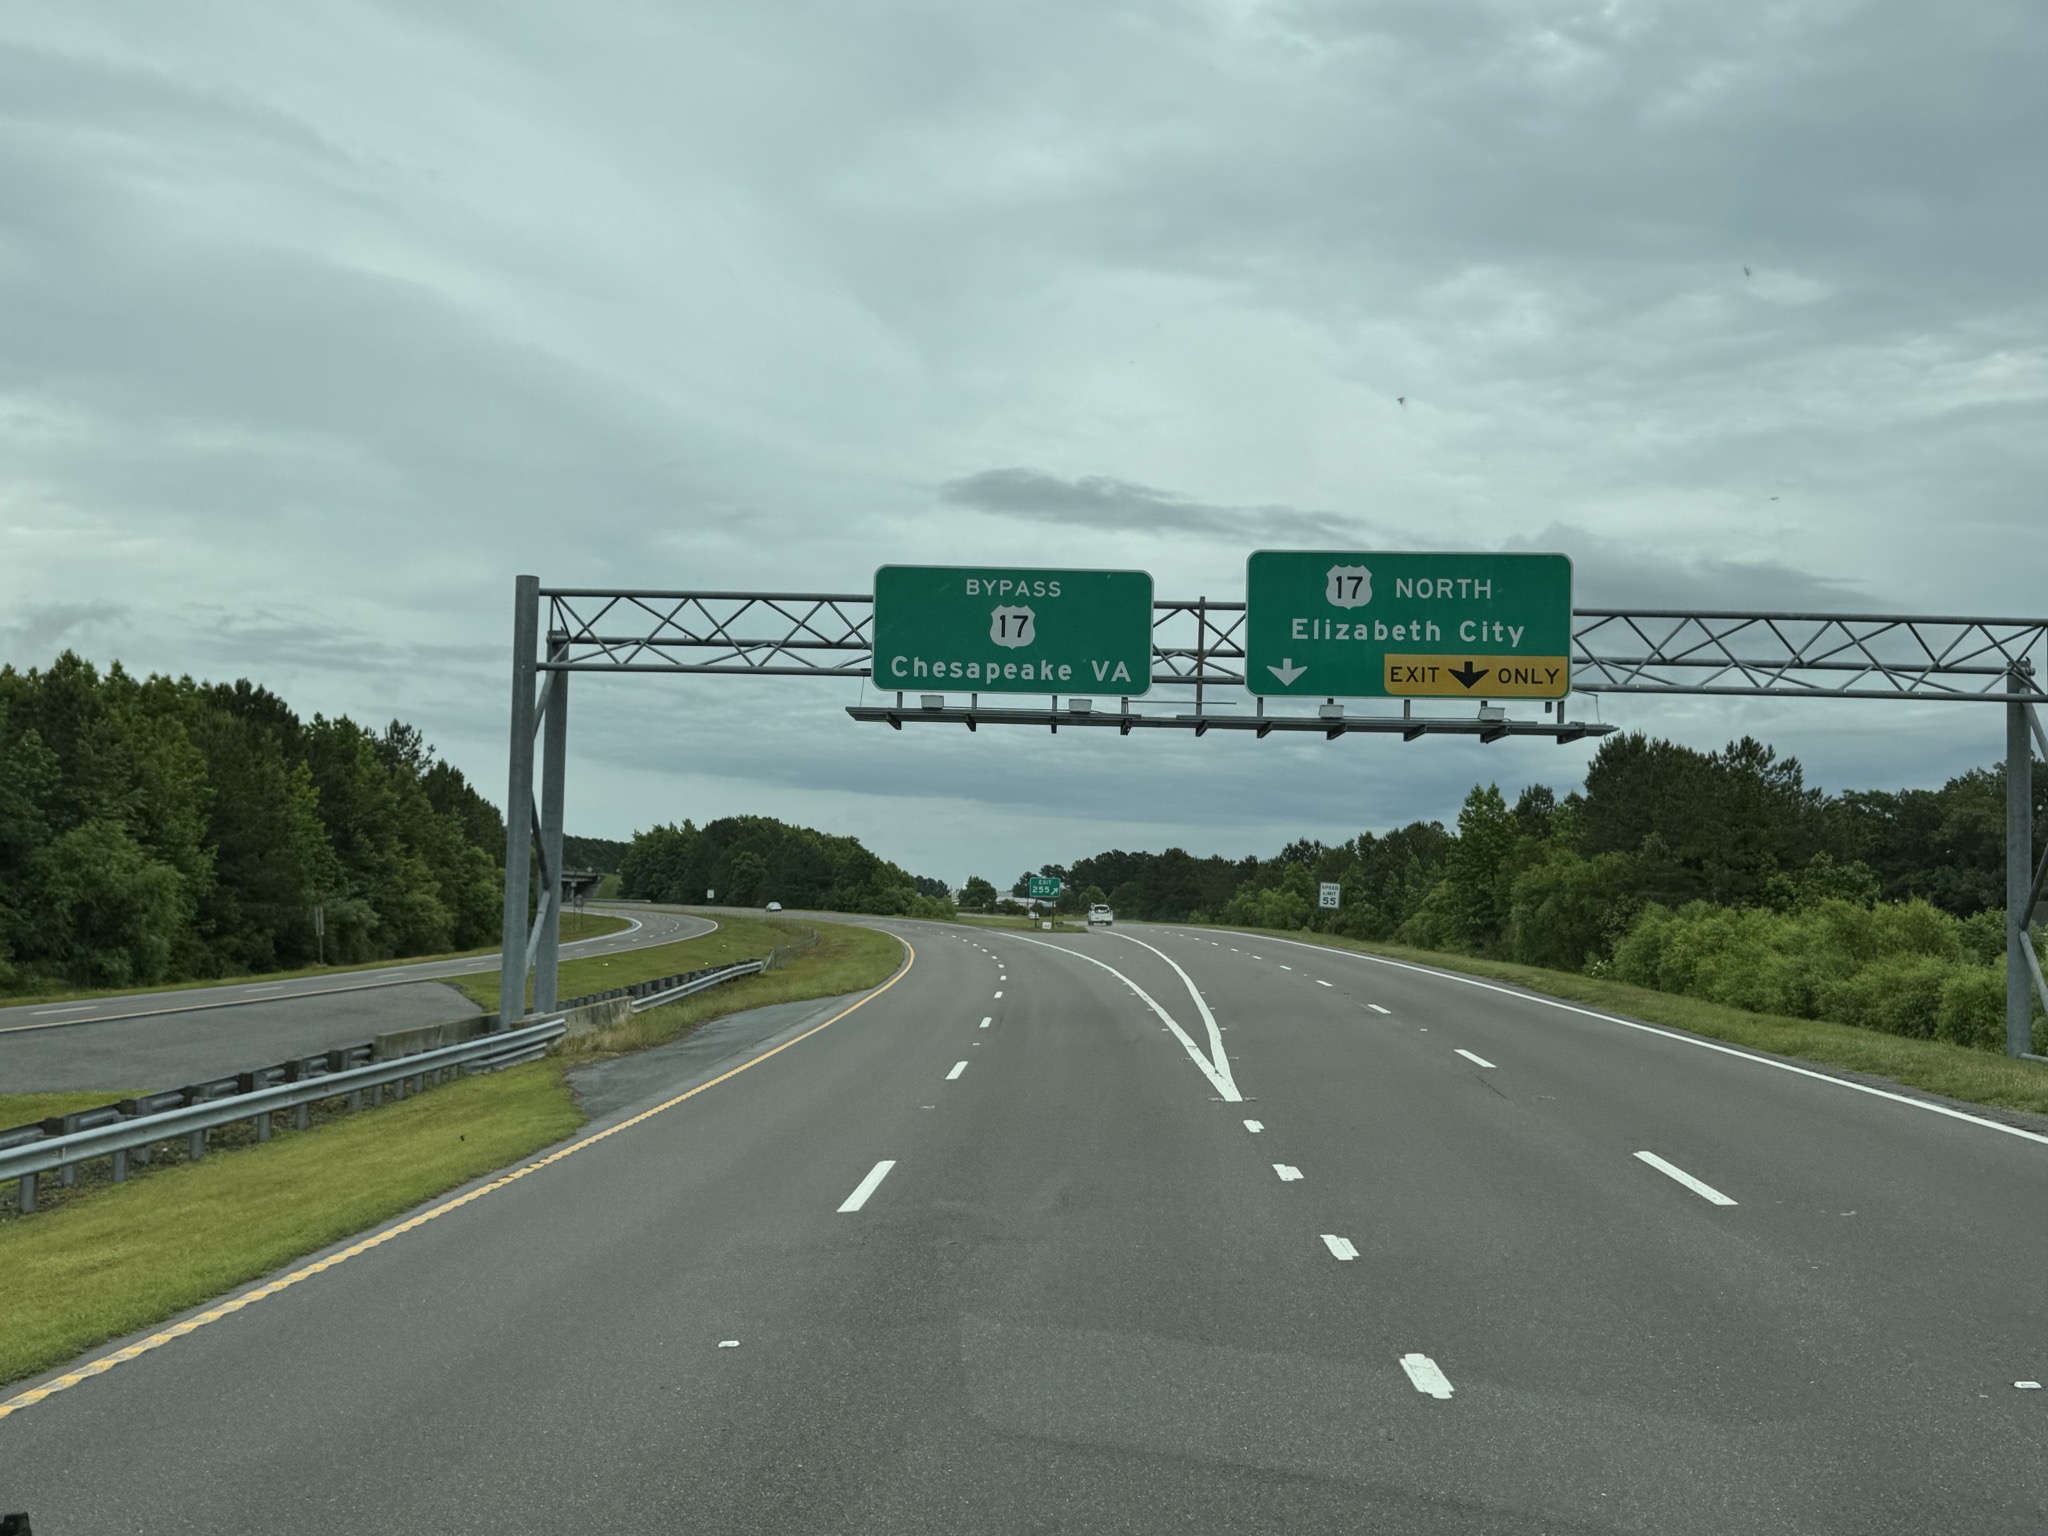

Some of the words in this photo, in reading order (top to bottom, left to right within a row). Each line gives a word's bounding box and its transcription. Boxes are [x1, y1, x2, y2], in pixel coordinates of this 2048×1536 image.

[966, 579, 1061, 597] BYPASS
[1335, 576, 1364, 600] 17
[1396, 578, 1492, 599] NORTH
[999, 614, 1029, 638] 17
[1291, 618, 1441, 641] Elizabeth
[1459, 620, 1524, 647] City
[891, 655, 1072, 684] Chesapeake
[1092, 660, 1131, 682] VA
[1390, 666, 1440, 683] EXIT
[1498, 667, 1560, 684] ONLY
[1032, 885, 1050, 893] 255
[1323, 897, 1336, 905] 55
